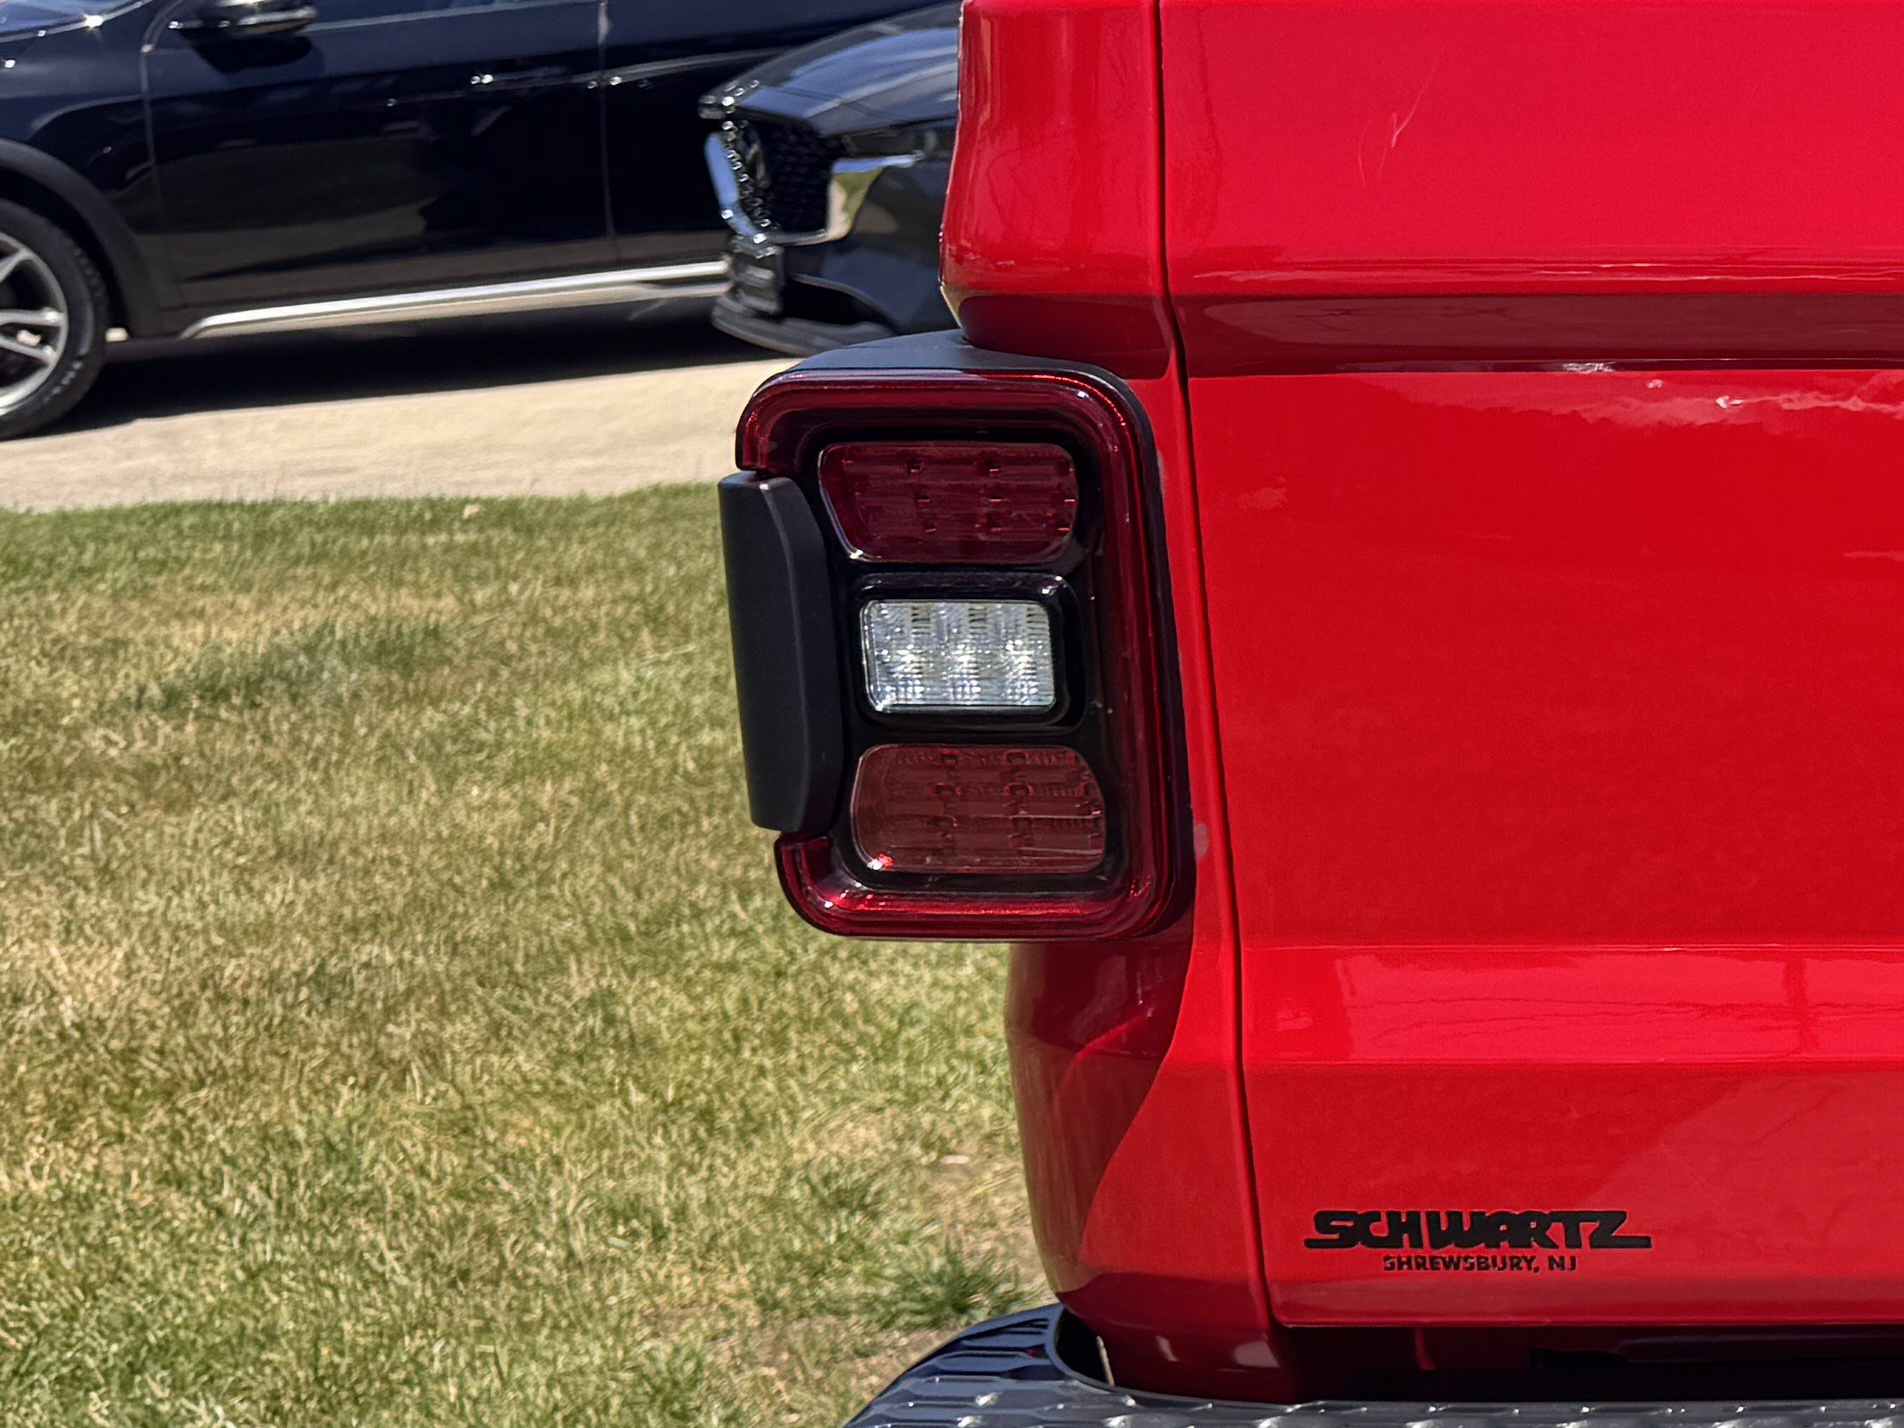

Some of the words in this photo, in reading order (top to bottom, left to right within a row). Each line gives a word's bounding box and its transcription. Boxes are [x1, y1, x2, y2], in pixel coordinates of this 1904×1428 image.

[1303, 1209, 1652, 1250] SCHWARTZ
[1382, 1254, 1541, 1274] SHREWSBURY,
[1547, 1254, 1577, 1272] NJ
